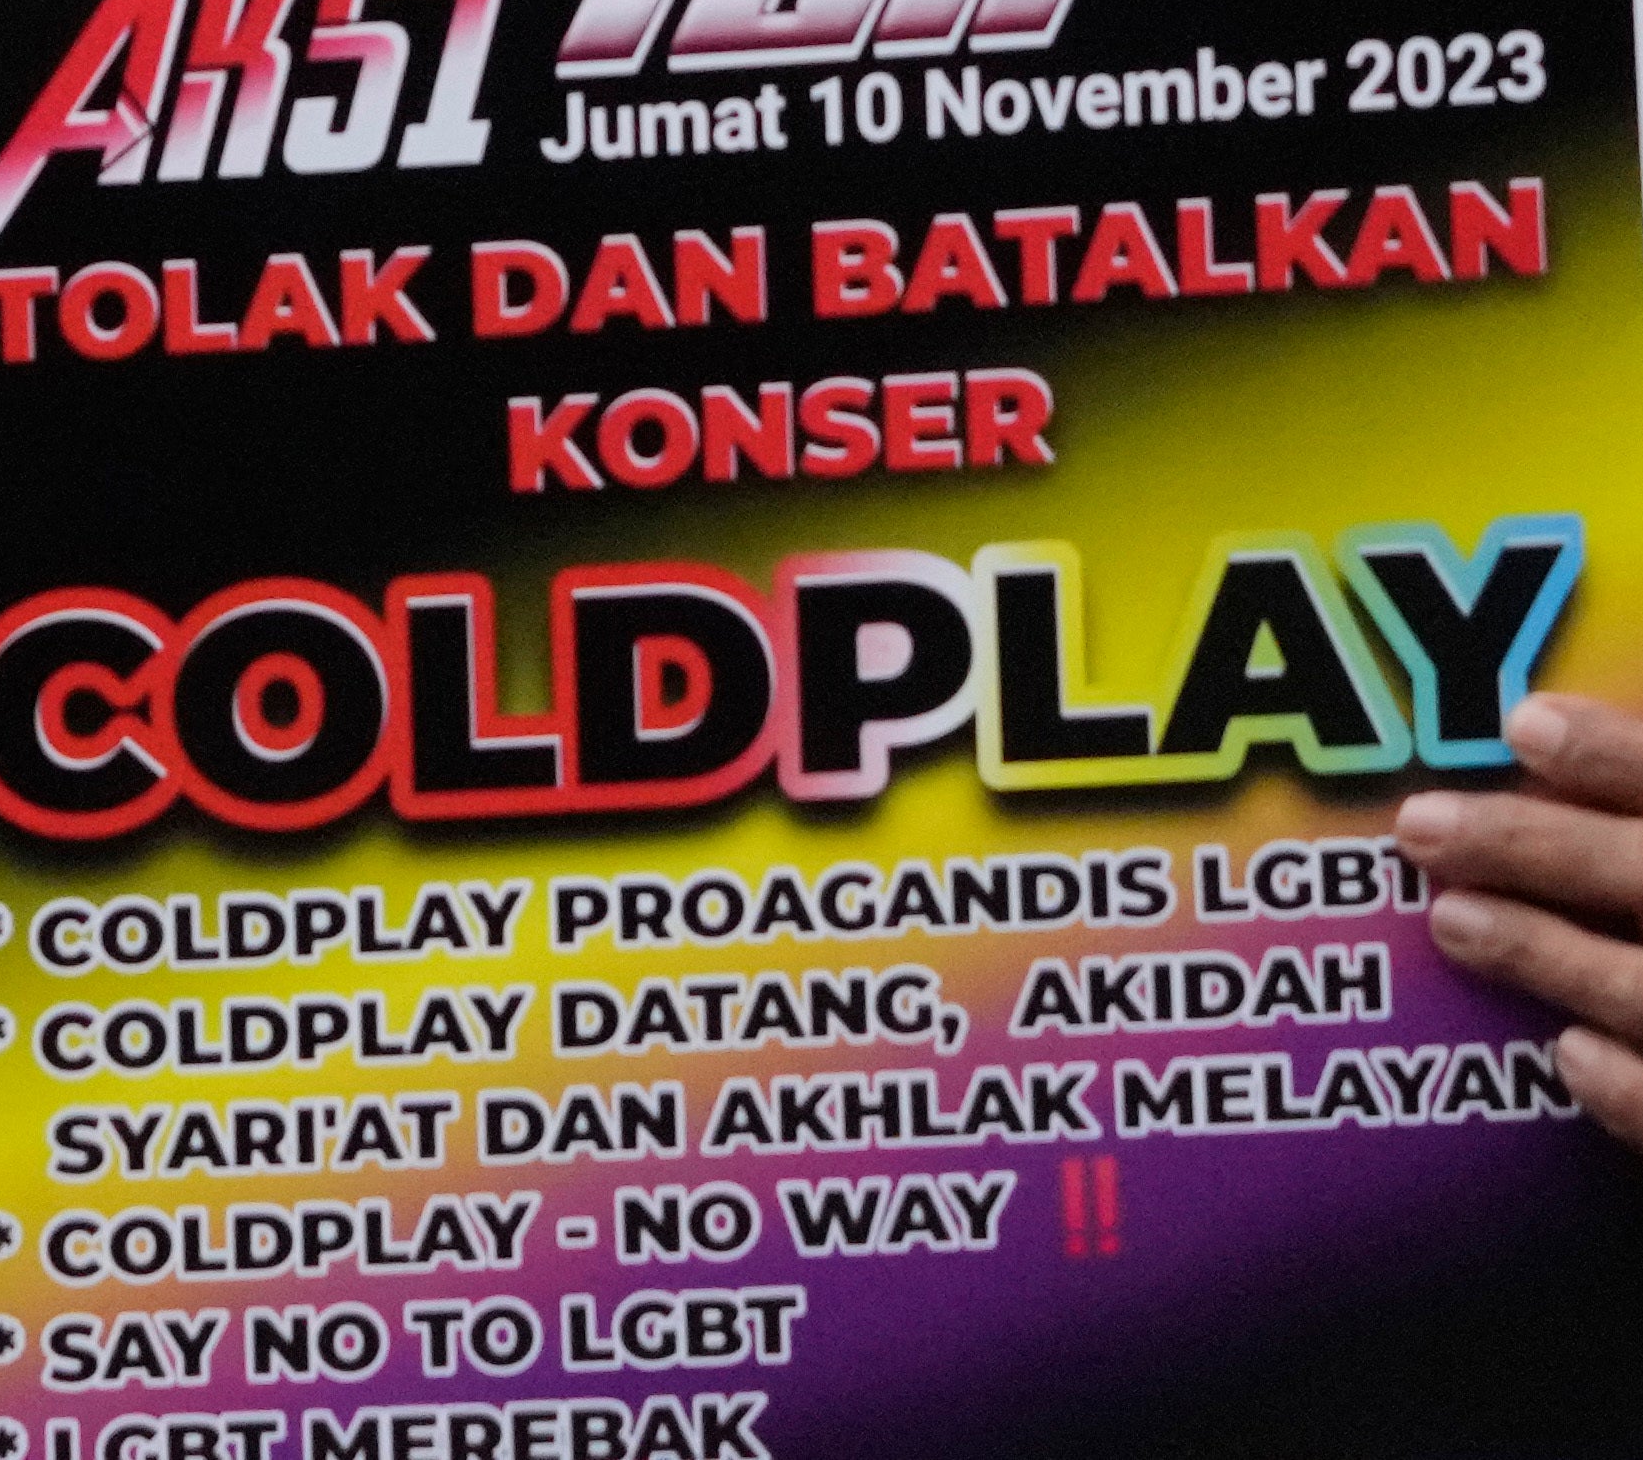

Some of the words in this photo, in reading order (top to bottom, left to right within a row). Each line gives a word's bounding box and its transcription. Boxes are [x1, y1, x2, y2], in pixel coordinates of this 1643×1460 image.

[539, 88, 785, 166] Jumat
[812, 76, 902, 147] 10
[924, 53, 1326, 141] November
[1346, 31, 1549, 108] 2023
[472, 227, 770, 339] DAN
[812, 177, 1549, 319] BATALKAN
[507, 366, 1055, 494] KONSER
[30, 878, 527, 977] COLDPLAY
[550, 845, 1171, 956] PROAGANDIS
[33, 987, 534, 1080] COLDPLAY
[554, 964, 969, 1060] DATANG,
[1011, 941, 1392, 1035] AKIDAH
[44, 1098, 453, 1185] SYARI'AT
[475, 1080, 682, 1166] DAN
[701, 1063, 1097, 1158] AKHLAK
[1111, 1039, 1580, 1137] MELAYAN
[37, 1191, 541, 1288] COLDPLAY
[618, 1177, 762, 1267] NO
[780, 1170, 1015, 1256] WAY
[40, 1309, 231, 1394] SAY
[246, 1299, 391, 1383] NO
[409, 1292, 542, 1375] TO
[561, 1282, 806, 1366] LGBT
